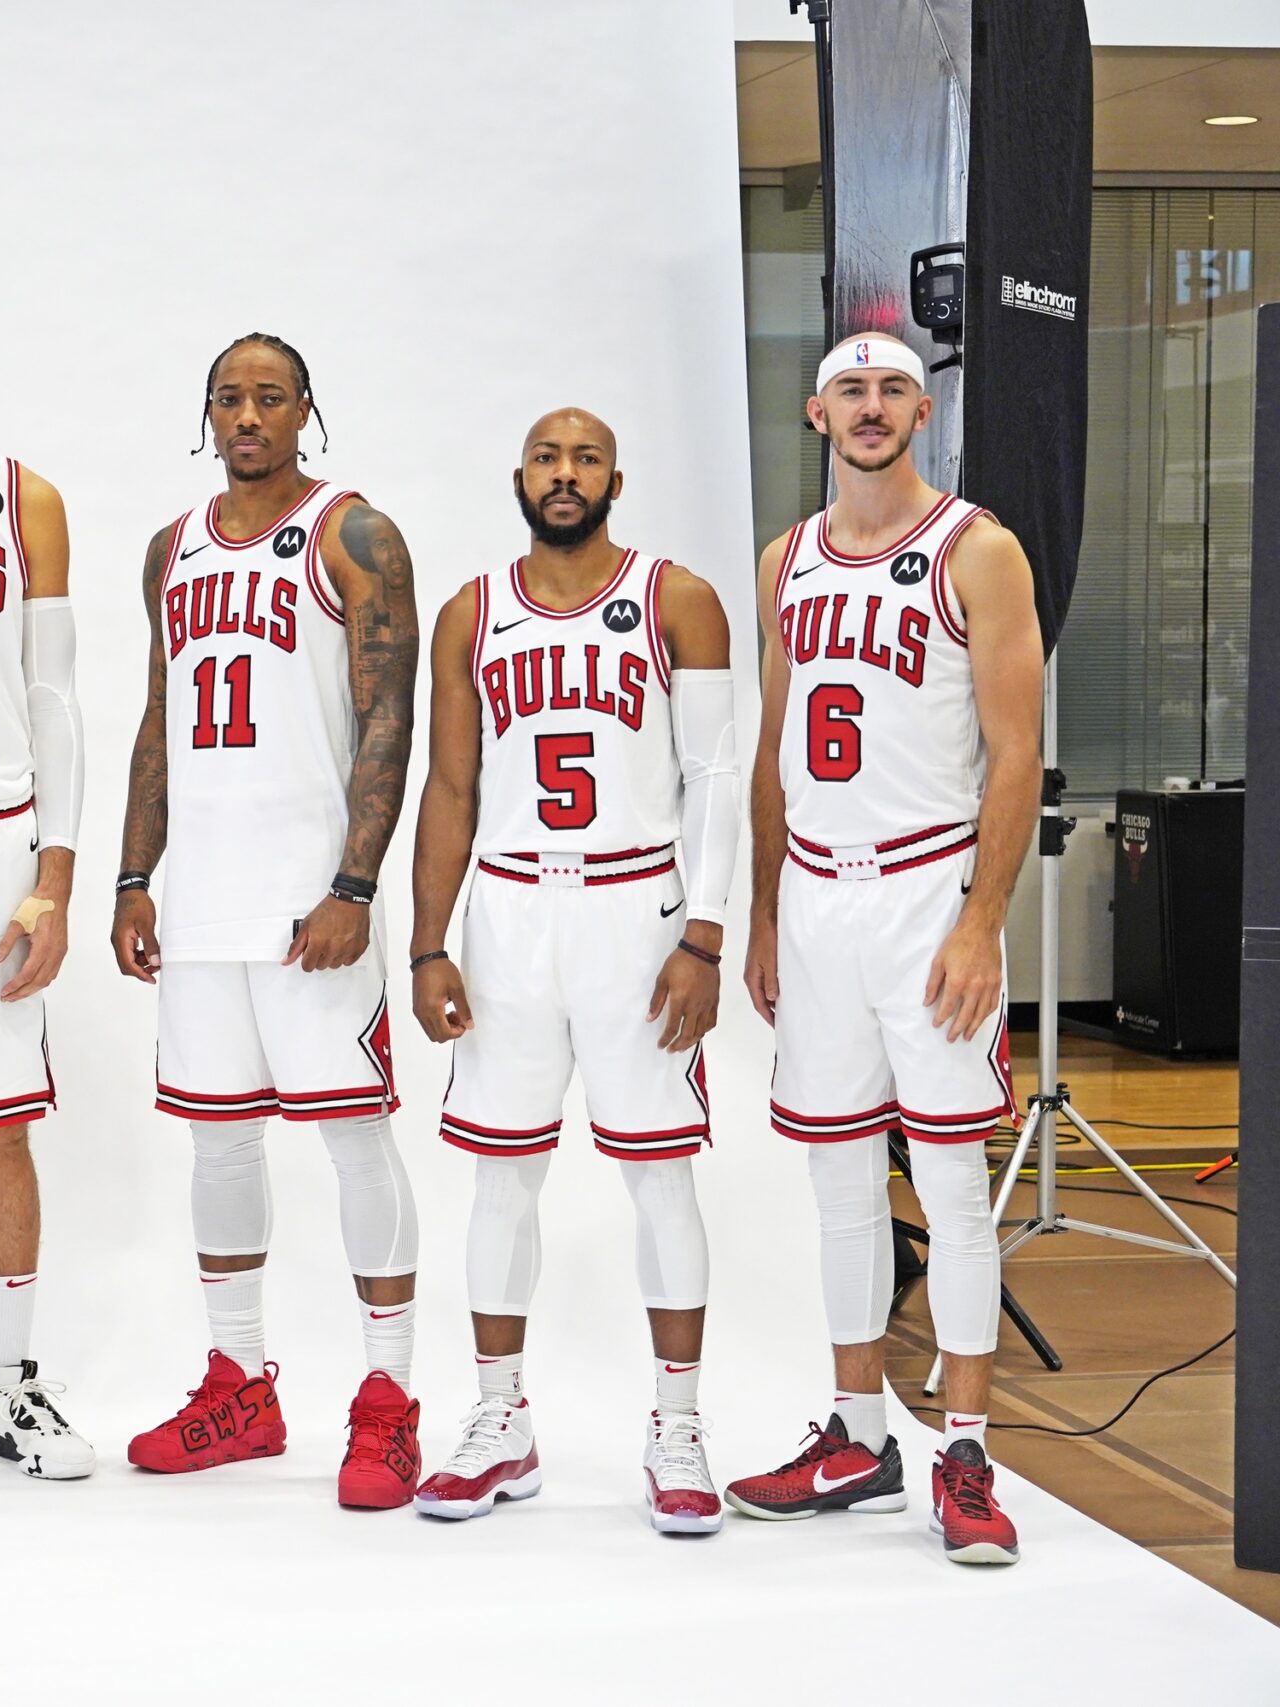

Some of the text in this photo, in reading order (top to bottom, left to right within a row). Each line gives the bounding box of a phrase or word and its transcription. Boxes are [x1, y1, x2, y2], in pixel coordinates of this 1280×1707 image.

[1015, 280, 1076, 313] elinchrom
[166, 571, 298, 661] BULLS
[779, 593, 931, 689] BULLS
[192, 654, 256, 750] 11
[481, 644, 648, 740] BULLS
[806, 683, 864, 783] 6
[534, 731, 597, 831] 5
[1121, 813, 1151, 829] CHICAGO
[1125, 827, 1146, 841] BULLS
